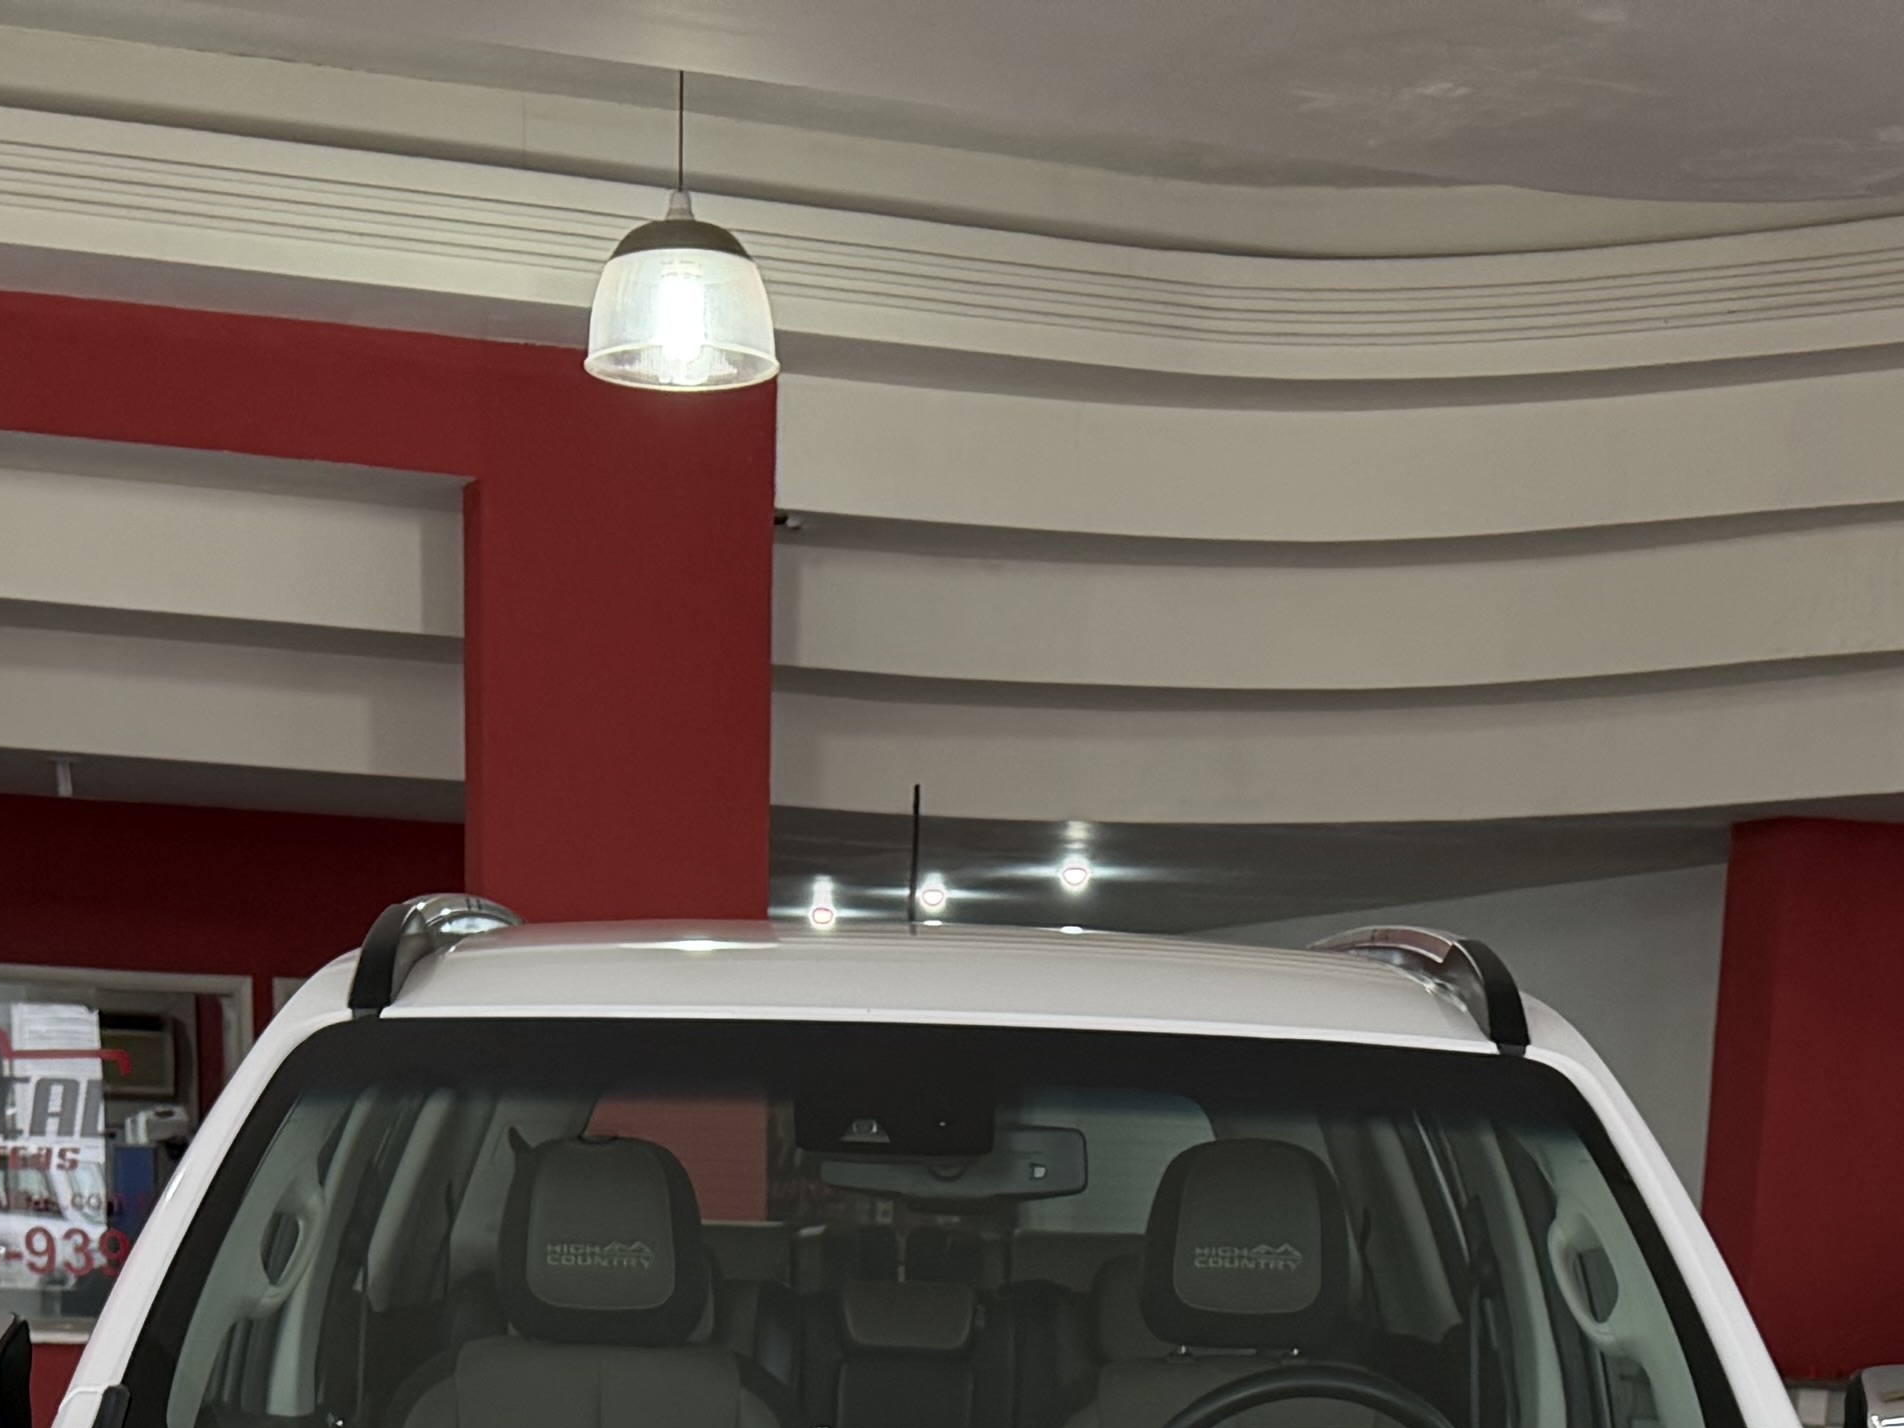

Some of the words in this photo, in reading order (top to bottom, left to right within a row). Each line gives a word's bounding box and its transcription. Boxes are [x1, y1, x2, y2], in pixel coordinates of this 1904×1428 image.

[546, 1243, 601, 1255] HIGH
[1194, 1246, 1250, 1257] HIGH
[546, 1254, 653, 1269] COUNTRY
[1193, 1256, 1301, 1272] COUNTRY
